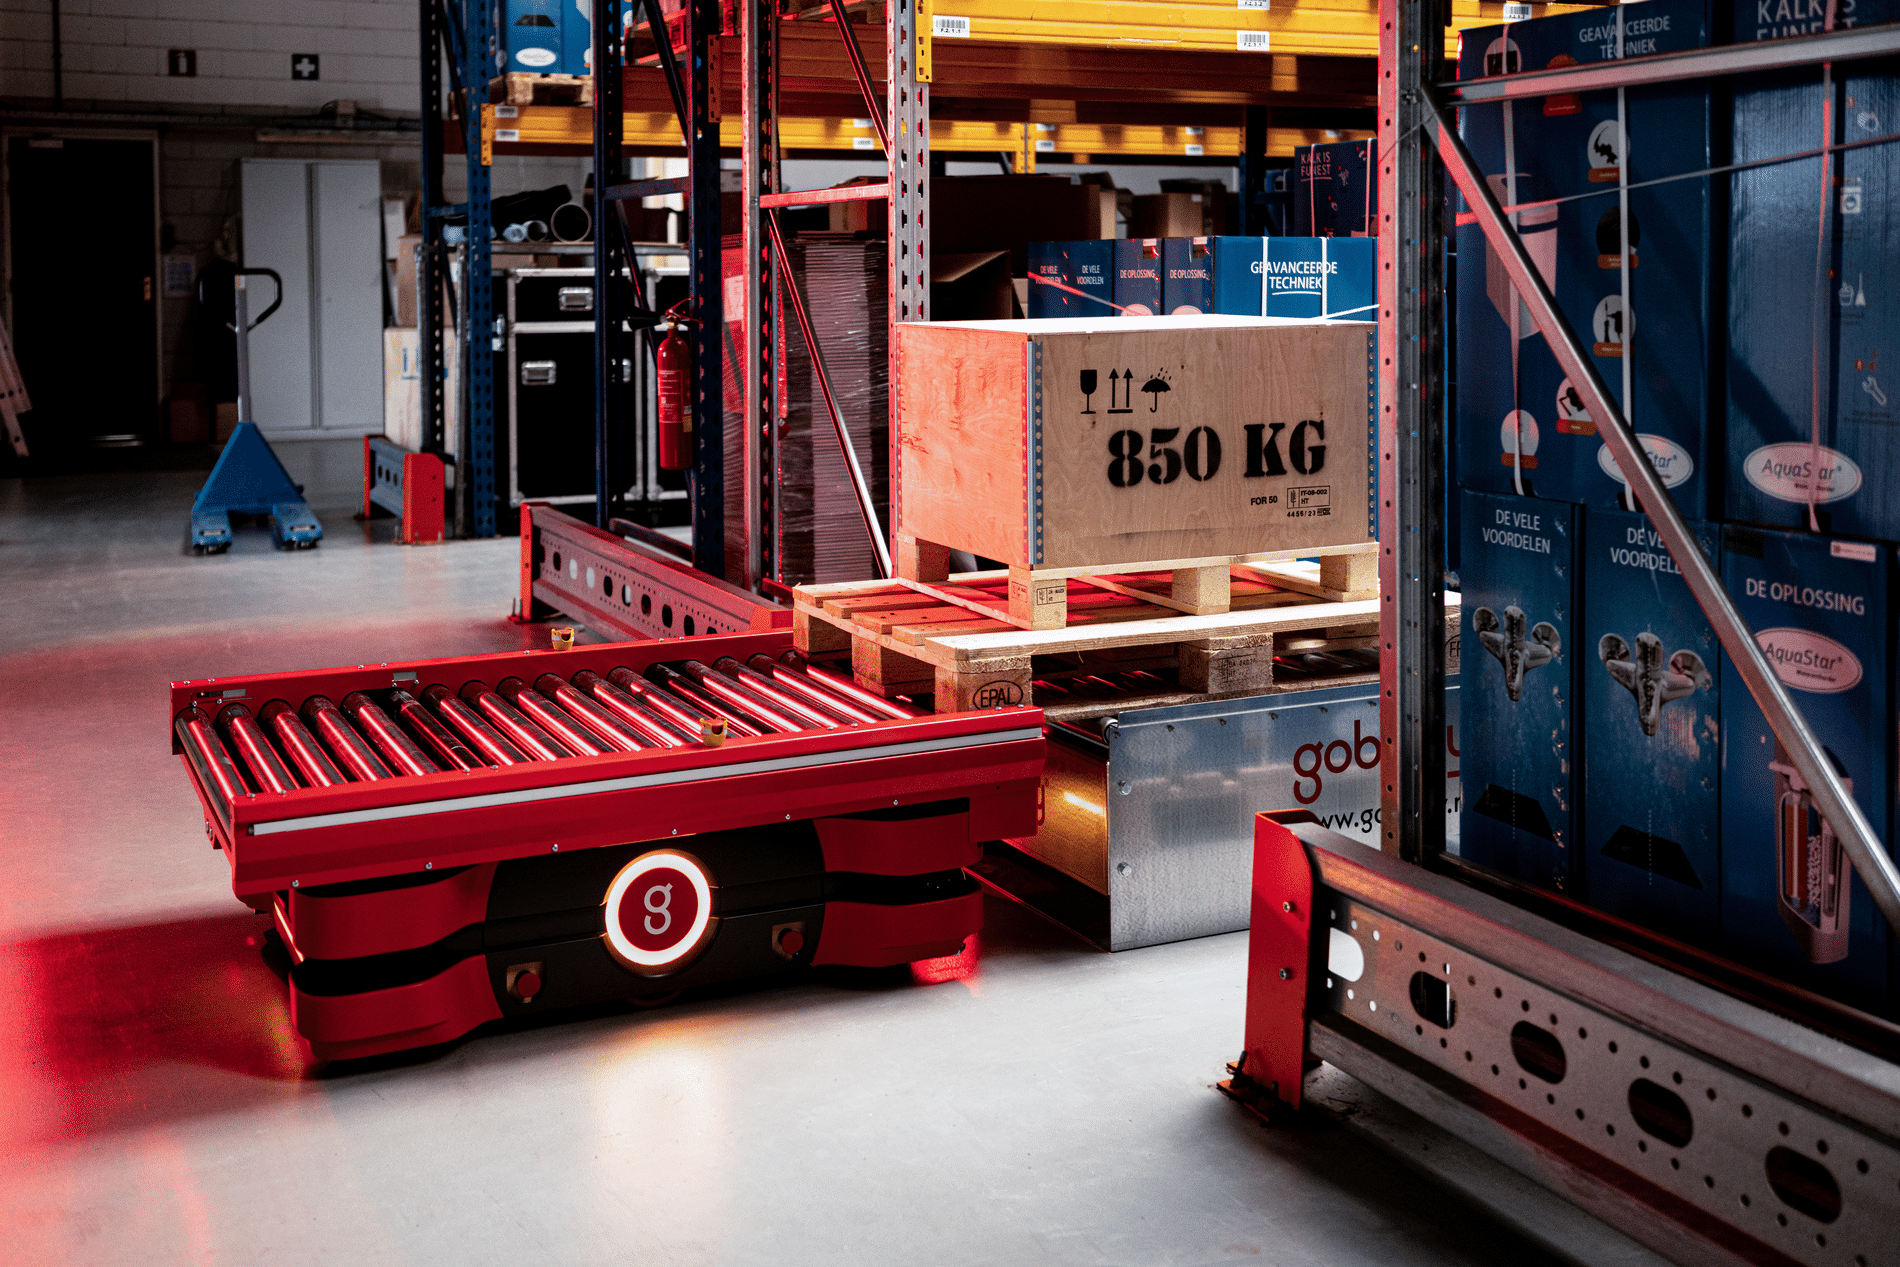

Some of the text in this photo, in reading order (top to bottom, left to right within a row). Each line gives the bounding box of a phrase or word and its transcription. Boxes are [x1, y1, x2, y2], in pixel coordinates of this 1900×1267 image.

[1076, 276, 1105, 285] VOORDELEN
[1269, 276, 1323, 290] TECHNIEK
[1107, 418, 1327, 488] 850 KG
[1250, 495, 1278, 506] FOR 50
[1495, 509, 1541, 532] DE VELE
[1482, 527, 1551, 555] VOORDELEN
[1626, 527, 1645, 546] DE
[1745, 577, 1866, 616] DE OPLOSSING
[980, 687, 1016, 709] EPAL
